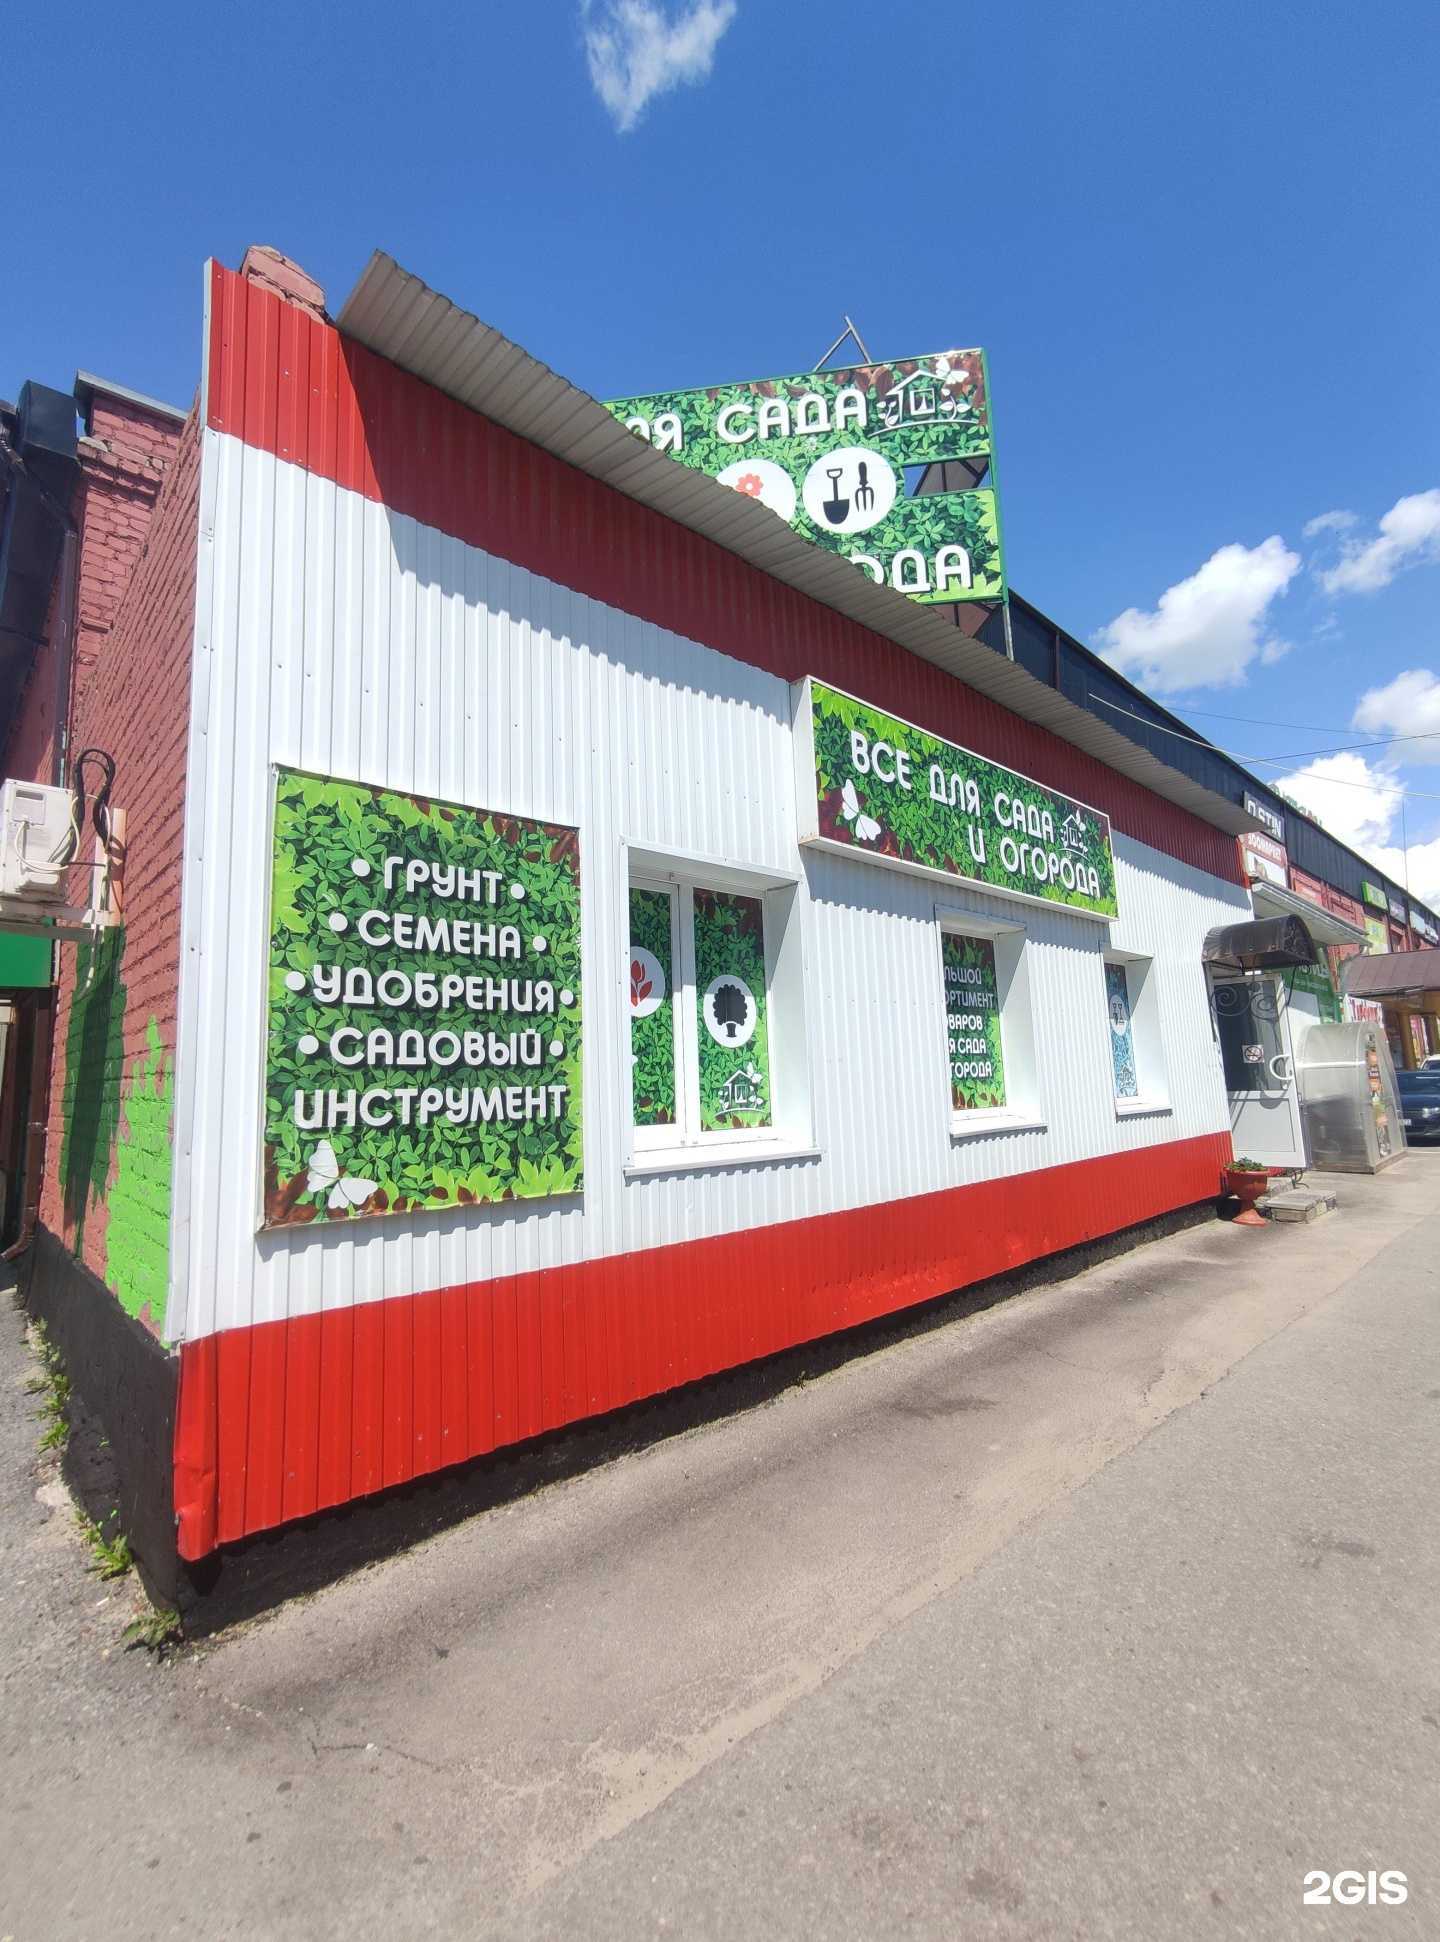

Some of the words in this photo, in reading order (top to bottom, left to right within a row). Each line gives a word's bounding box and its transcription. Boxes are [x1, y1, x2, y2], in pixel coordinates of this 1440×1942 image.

[716, 389, 867, 443] САДА
[850, 730, 911, 790] ВСЕ
[930, 765, 980, 817] ДЛЯ
[994, 792, 1054, 843] САДА
[384, 856, 502, 903] ГРУНТ
[968, 824, 986, 863] И
[1000, 837, 1101, 898] ОГОРОДА
[358, 910, 521, 958] СЕМЕНА
[313, 965, 555, 1012] УДОБРЕНИЯ
[947, 1014, 983, 1031] ВАРОВ
[958, 1038, 986, 1054] САДА
[330, 1028, 541, 1066] САДОВЫЙ
[294, 1085, 567, 1130] ИНСТРУМЕНТ
